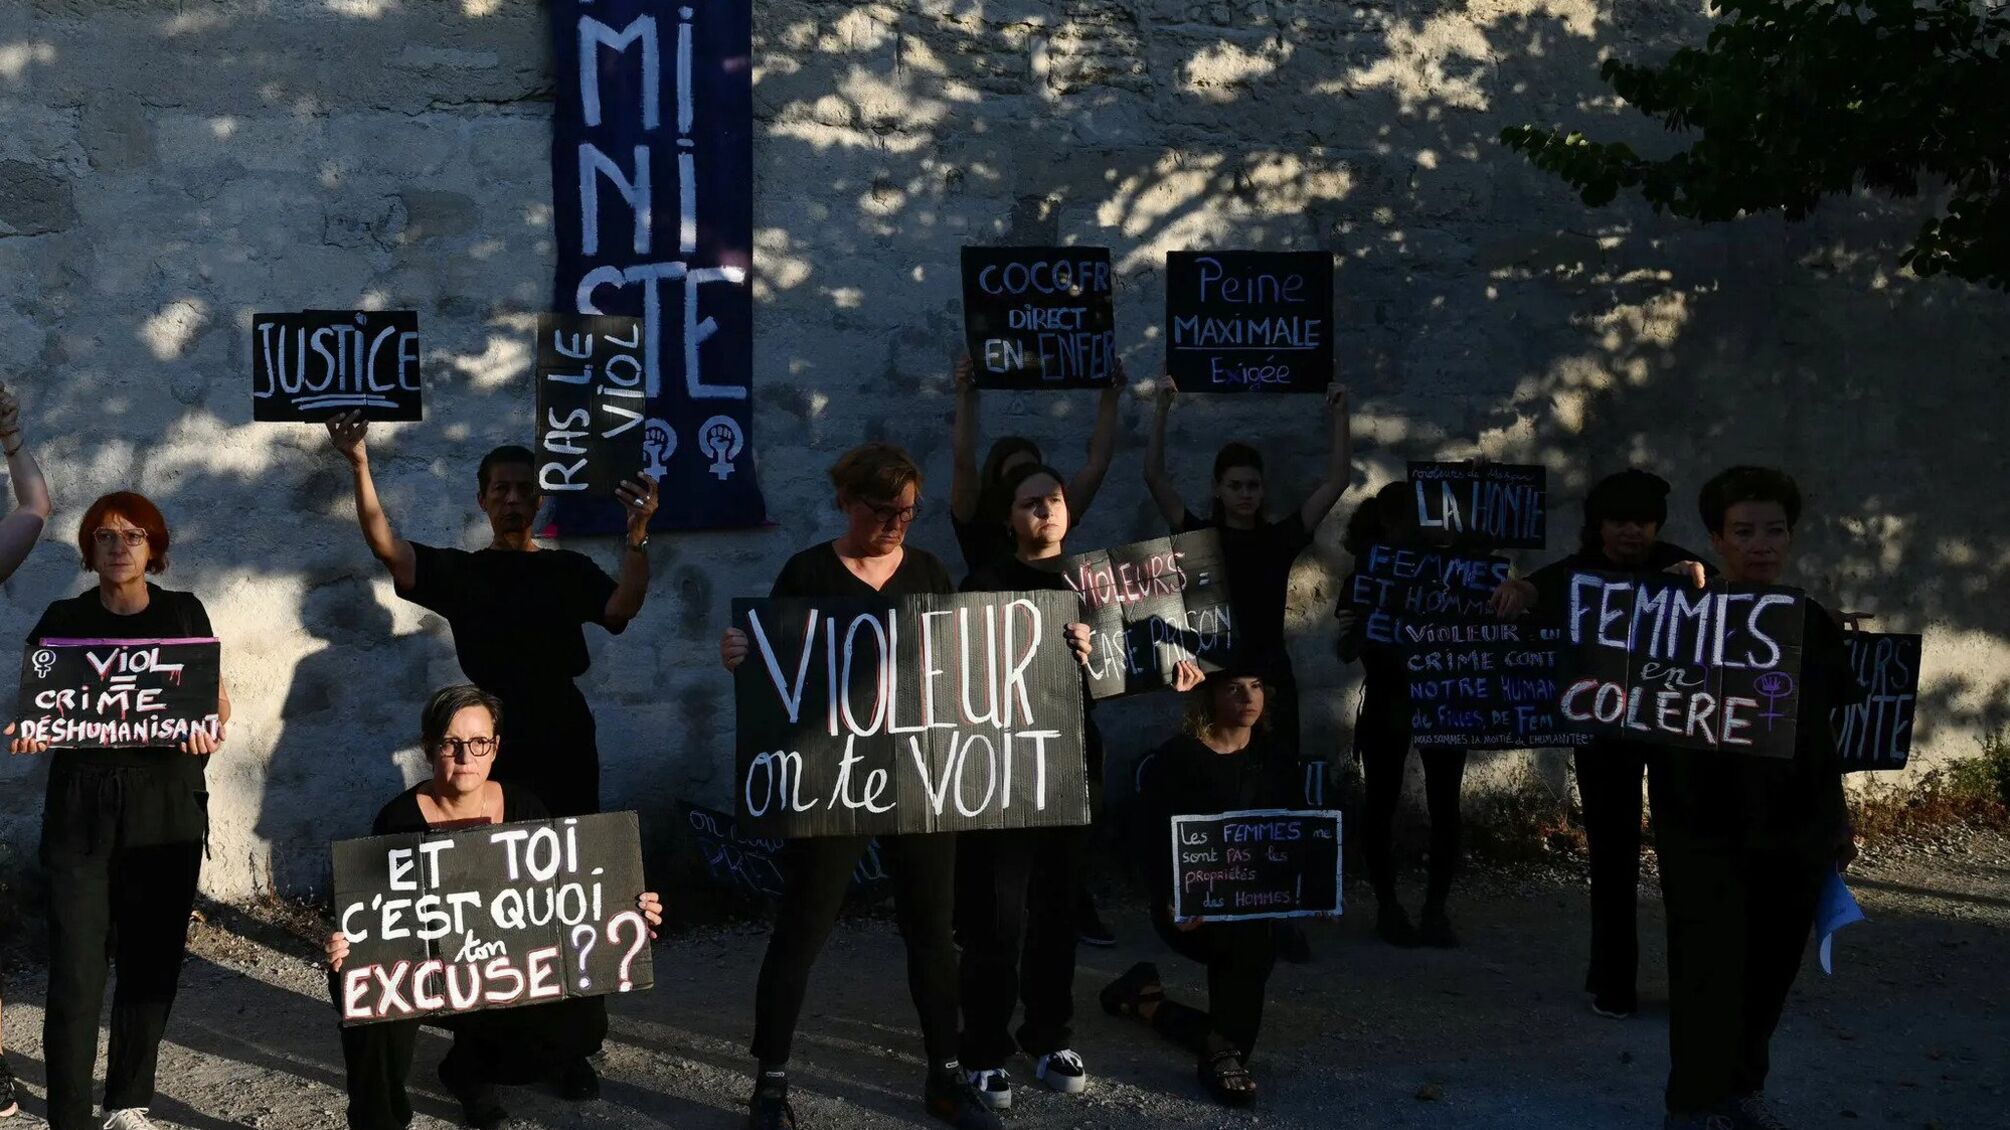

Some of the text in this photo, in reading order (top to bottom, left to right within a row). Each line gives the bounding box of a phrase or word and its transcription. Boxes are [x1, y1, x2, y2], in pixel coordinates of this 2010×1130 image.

[1194, 256, 1307, 304] Peine
[1008, 303, 1088, 331] DIRECT
[1173, 312, 1322, 346] MAXIMALE
[254, 312, 421, 398] JUSTICE
[984, 330, 1114, 381] EN ENFER
[596, 323, 645, 438] VIOL
[538, 329, 594, 491] RAS LE
[1415, 480, 1464, 534] LA
[1062, 551, 1188, 611] VIOLEURS
[1352, 573, 1396, 607] ET
[1367, 543, 1511, 593] FEMMES
[1405, 622, 1520, 643] VIOLEUR
[1568, 571, 1796, 669] FEMMES
[86, 646, 185, 684] VIOL
[748, 598, 1042, 737] VIOLEUR
[1406, 649, 1496, 672] CRIME
[1640, 660, 1704, 691] en
[34, 684, 168, 719] CRIME
[1410, 676, 1489, 699] NOTRE
[1560, 677, 1760, 745] COLÈRE
[20, 713, 220, 746] DÉSHUMANISANT
[745, 749, 819, 818] on
[827, 733, 897, 814] te
[909, 730, 1062, 817] VOIT
[388, 818, 578, 891] ET TOI
[1182, 848, 1219, 864] sont
[1226, 848, 1251, 864] PAS
[1222, 822, 1301, 843] FEMMES
[341, 867, 604, 943] C'EST QUOI
[1202, 891, 1226, 909] des
[1234, 890, 1291, 907] HOMMES
[454, 929, 507, 963] ton
[343, 944, 563, 1020] EXCUSE
